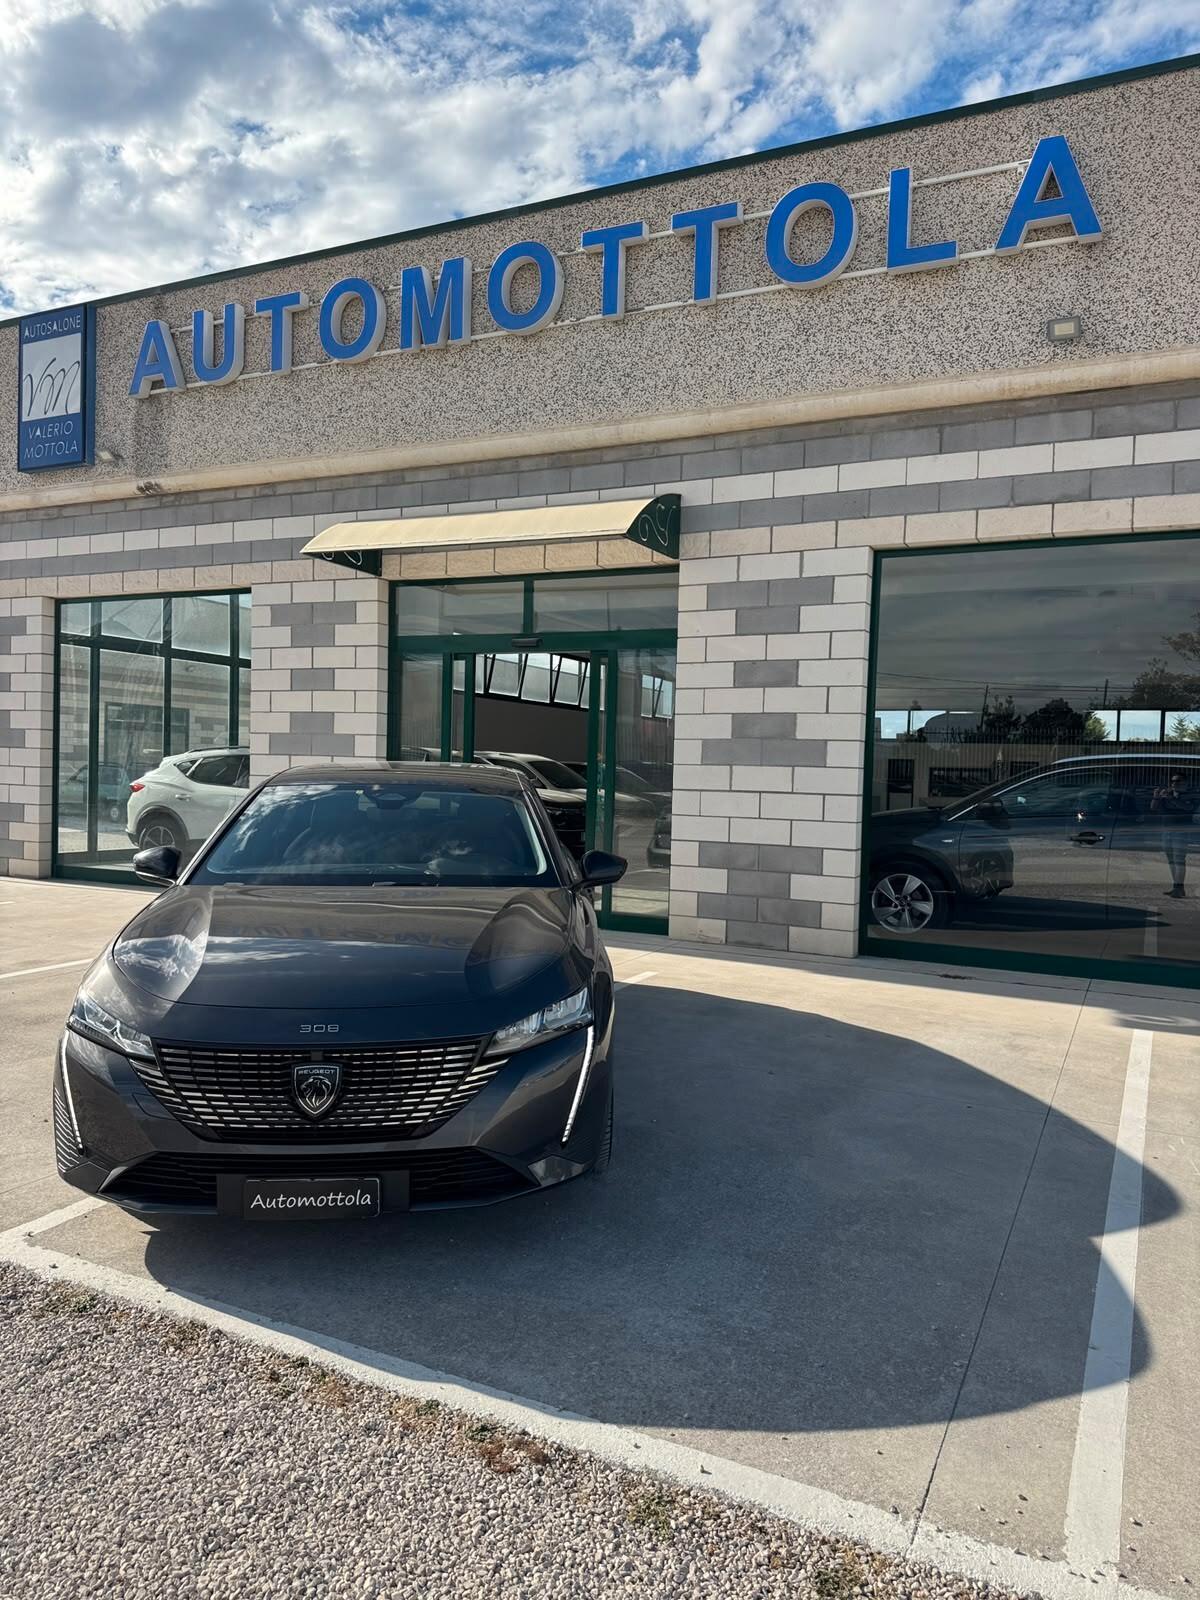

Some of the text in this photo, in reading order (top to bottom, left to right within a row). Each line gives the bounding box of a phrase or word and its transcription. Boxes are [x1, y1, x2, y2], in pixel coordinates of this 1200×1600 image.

[129, 135, 1103, 399] AUTOMOTTOLA
[24, 315, 81, 339] AUTOSALONE
[28, 421, 73, 439] VALERIO
[24, 440, 78, 459] MOTTOLA
[299, 1024, 340, 1033] 308
[250, 1189, 372, 1209] Automottola
